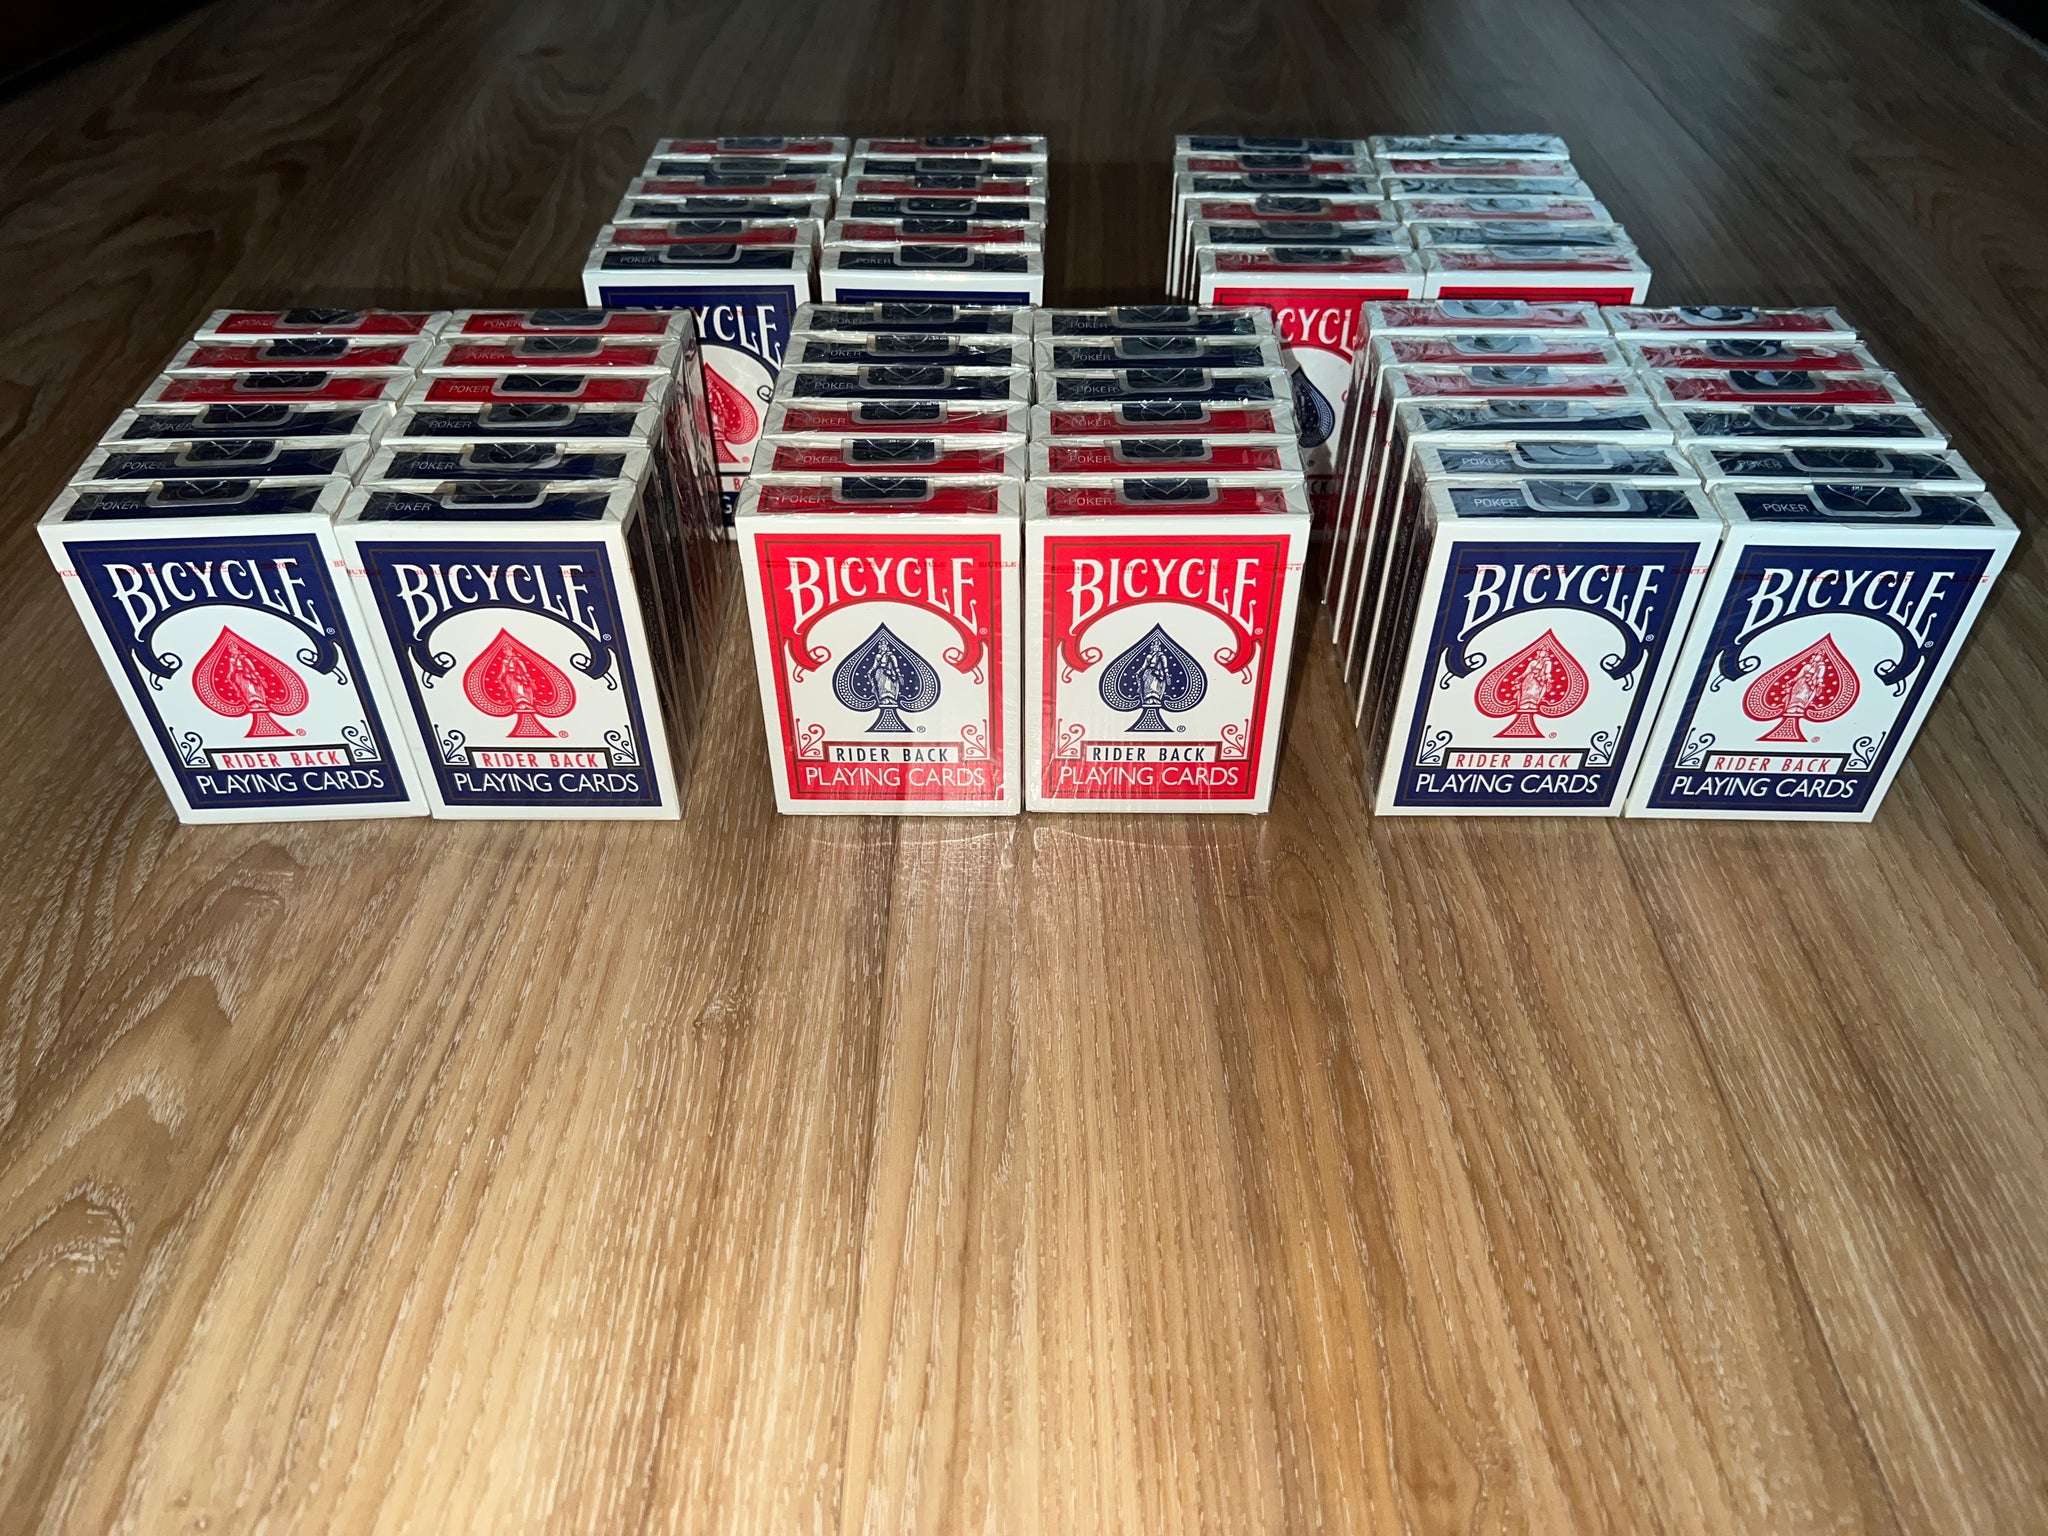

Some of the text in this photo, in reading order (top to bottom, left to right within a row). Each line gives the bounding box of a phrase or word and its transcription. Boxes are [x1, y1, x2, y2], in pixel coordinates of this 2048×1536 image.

[620, 256, 656, 264] POKER
[829, 349, 864, 358] OKER
[1072, 353, 1112, 361] POKER
[449, 385, 491, 394] POKER
[815, 382, 855, 391] POKER
[1076, 385, 1117, 394] POKER
[151, 422, 193, 431] POKER
[430, 420, 472, 429] POKER
[411, 461, 456, 471] POKER
[1070, 455, 1112, 464] POKER
[1461, 457, 1507, 467] POKER
[96, 501, 140, 511] POKER
[781, 495, 827, 504] POKER
[1069, 497, 1113, 507] POKER
[1472, 498, 1520, 508] POKER
[386, 502, 433, 512] POKER
[1762, 503, 1810, 513] POKER
[102, 558, 326, 643] BICYCLE
[391, 564, 603, 642] BICYCLE
[785, 557, 977, 635] BICYCLE
[1066, 558, 1260, 636] BICYCLE
[1456, 564, 1665, 643] BICYCLE
[1734, 568, 1956, 650] BICYCLE
[222, 750, 342, 768] RIDER BACK
[481, 753, 599, 768] RIDER BACK
[836, 748, 949, 762] RIDER BACK
[1092, 747, 1205, 761] RIDER BACK
[1455, 753, 1571, 768] RIDER BACK
[1714, 756, 1832, 773] RIDER BACK
[195, 769, 385, 795] PLAYING CARDS
[454, 773, 639, 793] PLAYING CARDS
[806, 767, 986, 787] PLAYING CARDS
[1060, 766, 1239, 786] PLAYING CARDS
[1415, 773, 1601, 794] PLAYING CARDS
[1670, 775, 1858, 798] PLAYING CARDS
